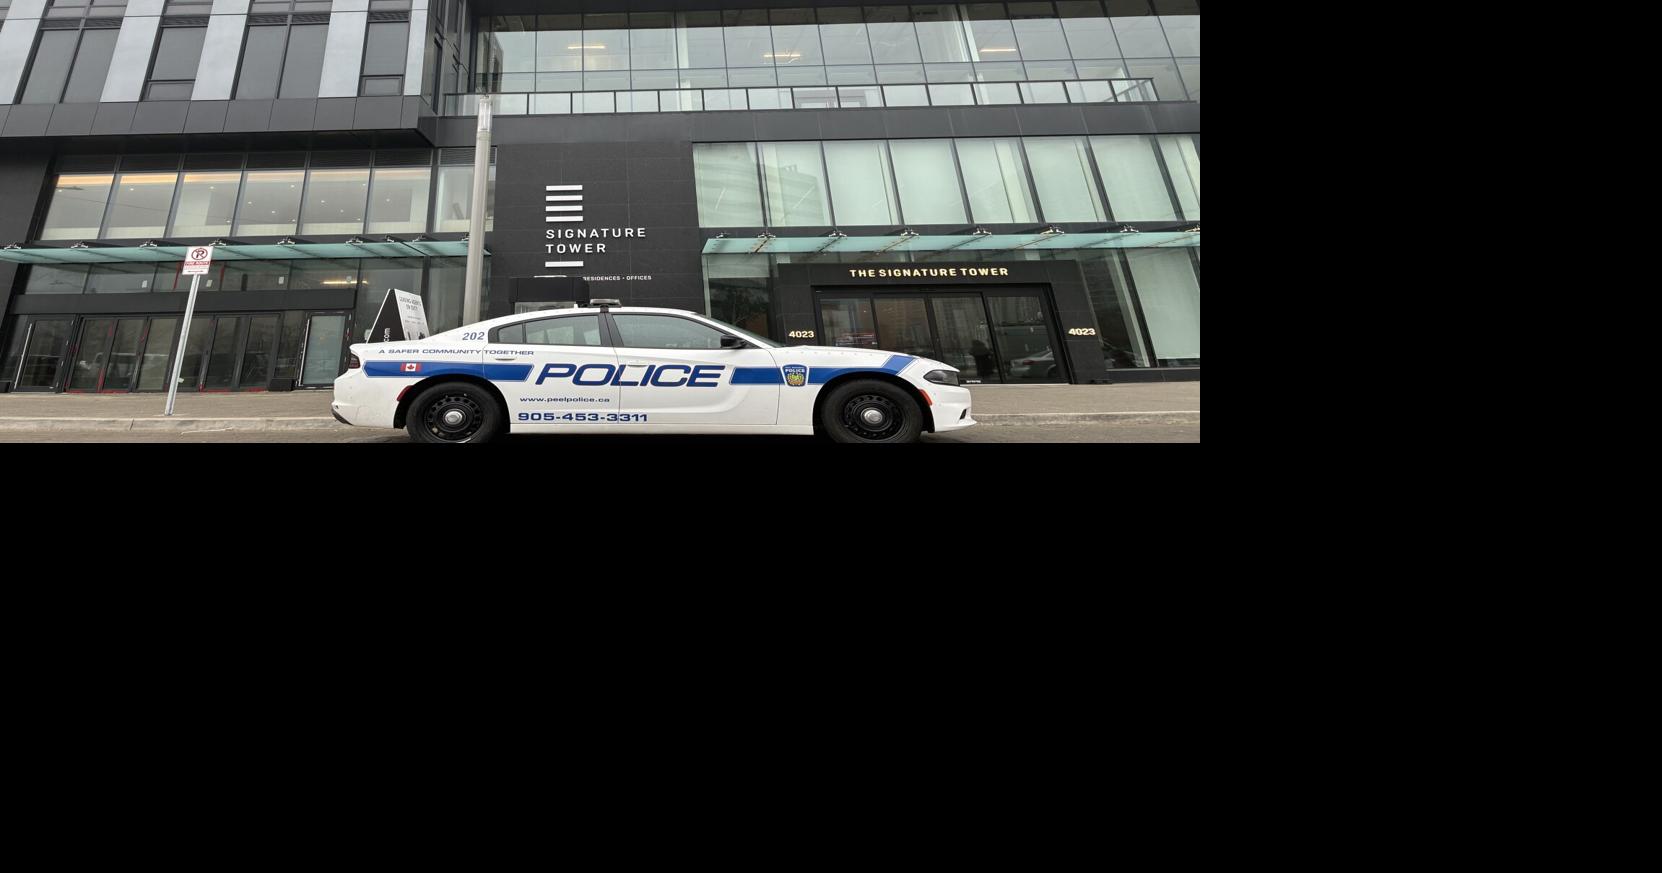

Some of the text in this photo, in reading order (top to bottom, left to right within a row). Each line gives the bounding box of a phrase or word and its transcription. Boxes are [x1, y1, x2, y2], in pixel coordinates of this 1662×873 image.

[545, 228, 646, 239] SIGNATURE
[545, 243, 606, 253] TOWER
[849, 267, 1009, 278] THE SIGNATURE TOWER
[462, 332, 484, 340] 202
[789, 330, 814, 338] 4023
[1068, 327, 1096, 336] 4023
[535, 363, 726, 387] POLICE
[518, 412, 648, 422] 905-453-3311
